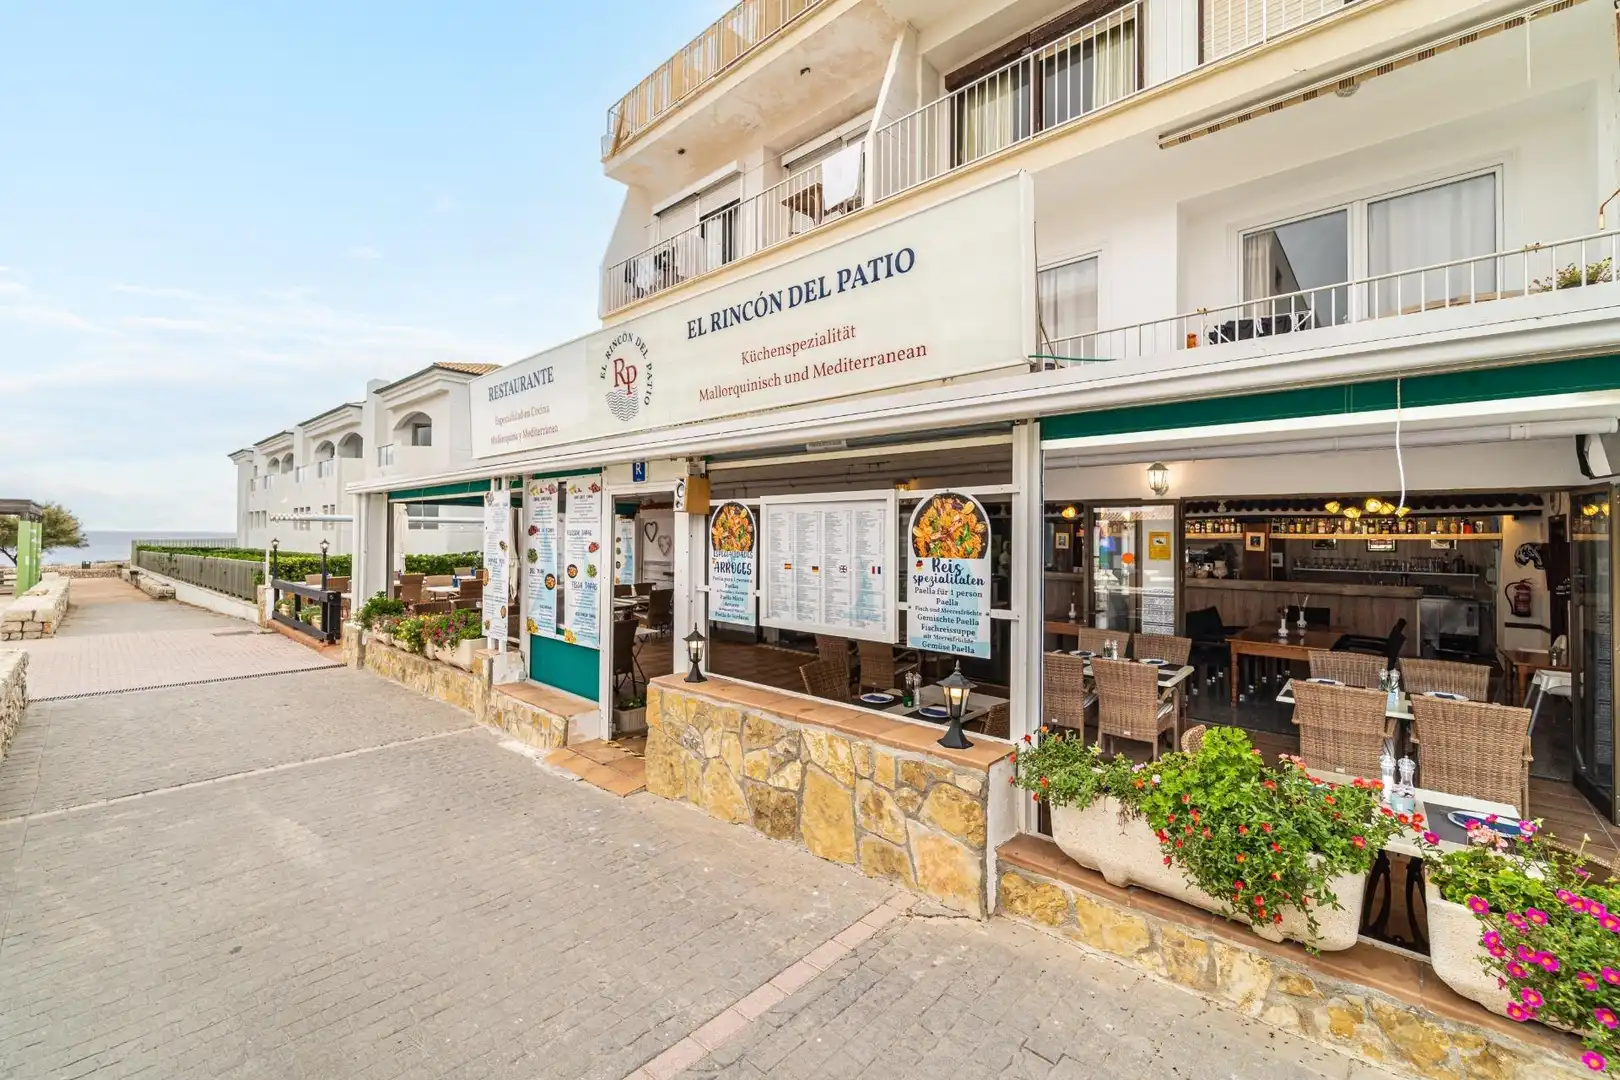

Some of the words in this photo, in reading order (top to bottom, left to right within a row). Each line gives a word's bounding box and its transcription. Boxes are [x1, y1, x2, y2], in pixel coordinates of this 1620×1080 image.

[687, 317, 706, 340] EL
[710, 290, 782, 332] RINCÓN
[788, 276, 832, 309] DEL
[837, 248, 916, 294] PATIO
[741, 325, 856, 364] Küchenspezialität
[600, 364, 608, 380] EL
[604, 330, 634, 360] RINCÓN
[636, 336, 647, 360] DEL
[644, 363, 653, 406] PATIO
[699, 374, 782, 402] Mallorquinisch
[784, 366, 809, 384] und
[813, 344, 928, 379] Mediterranean
[488, 366, 554, 402] RESTAURANTE
[531, 404, 550, 417] Cocina
[636, 462, 642, 474] R
[714, 562, 752, 576] ARROCES
[932, 558, 964, 576] Reis
[914, 587, 936, 596] Paella
[937, 588, 948, 596] für
[956, 590, 982, 599] person
[936, 598, 959, 606] Paella
[917, 614, 955, 625] Gemischte
[956, 616, 980, 626] Paella
[921, 624, 976, 638] Fischreissuppe
[922, 641, 950, 650] Gemüse
[952, 644, 975, 654] Paella
